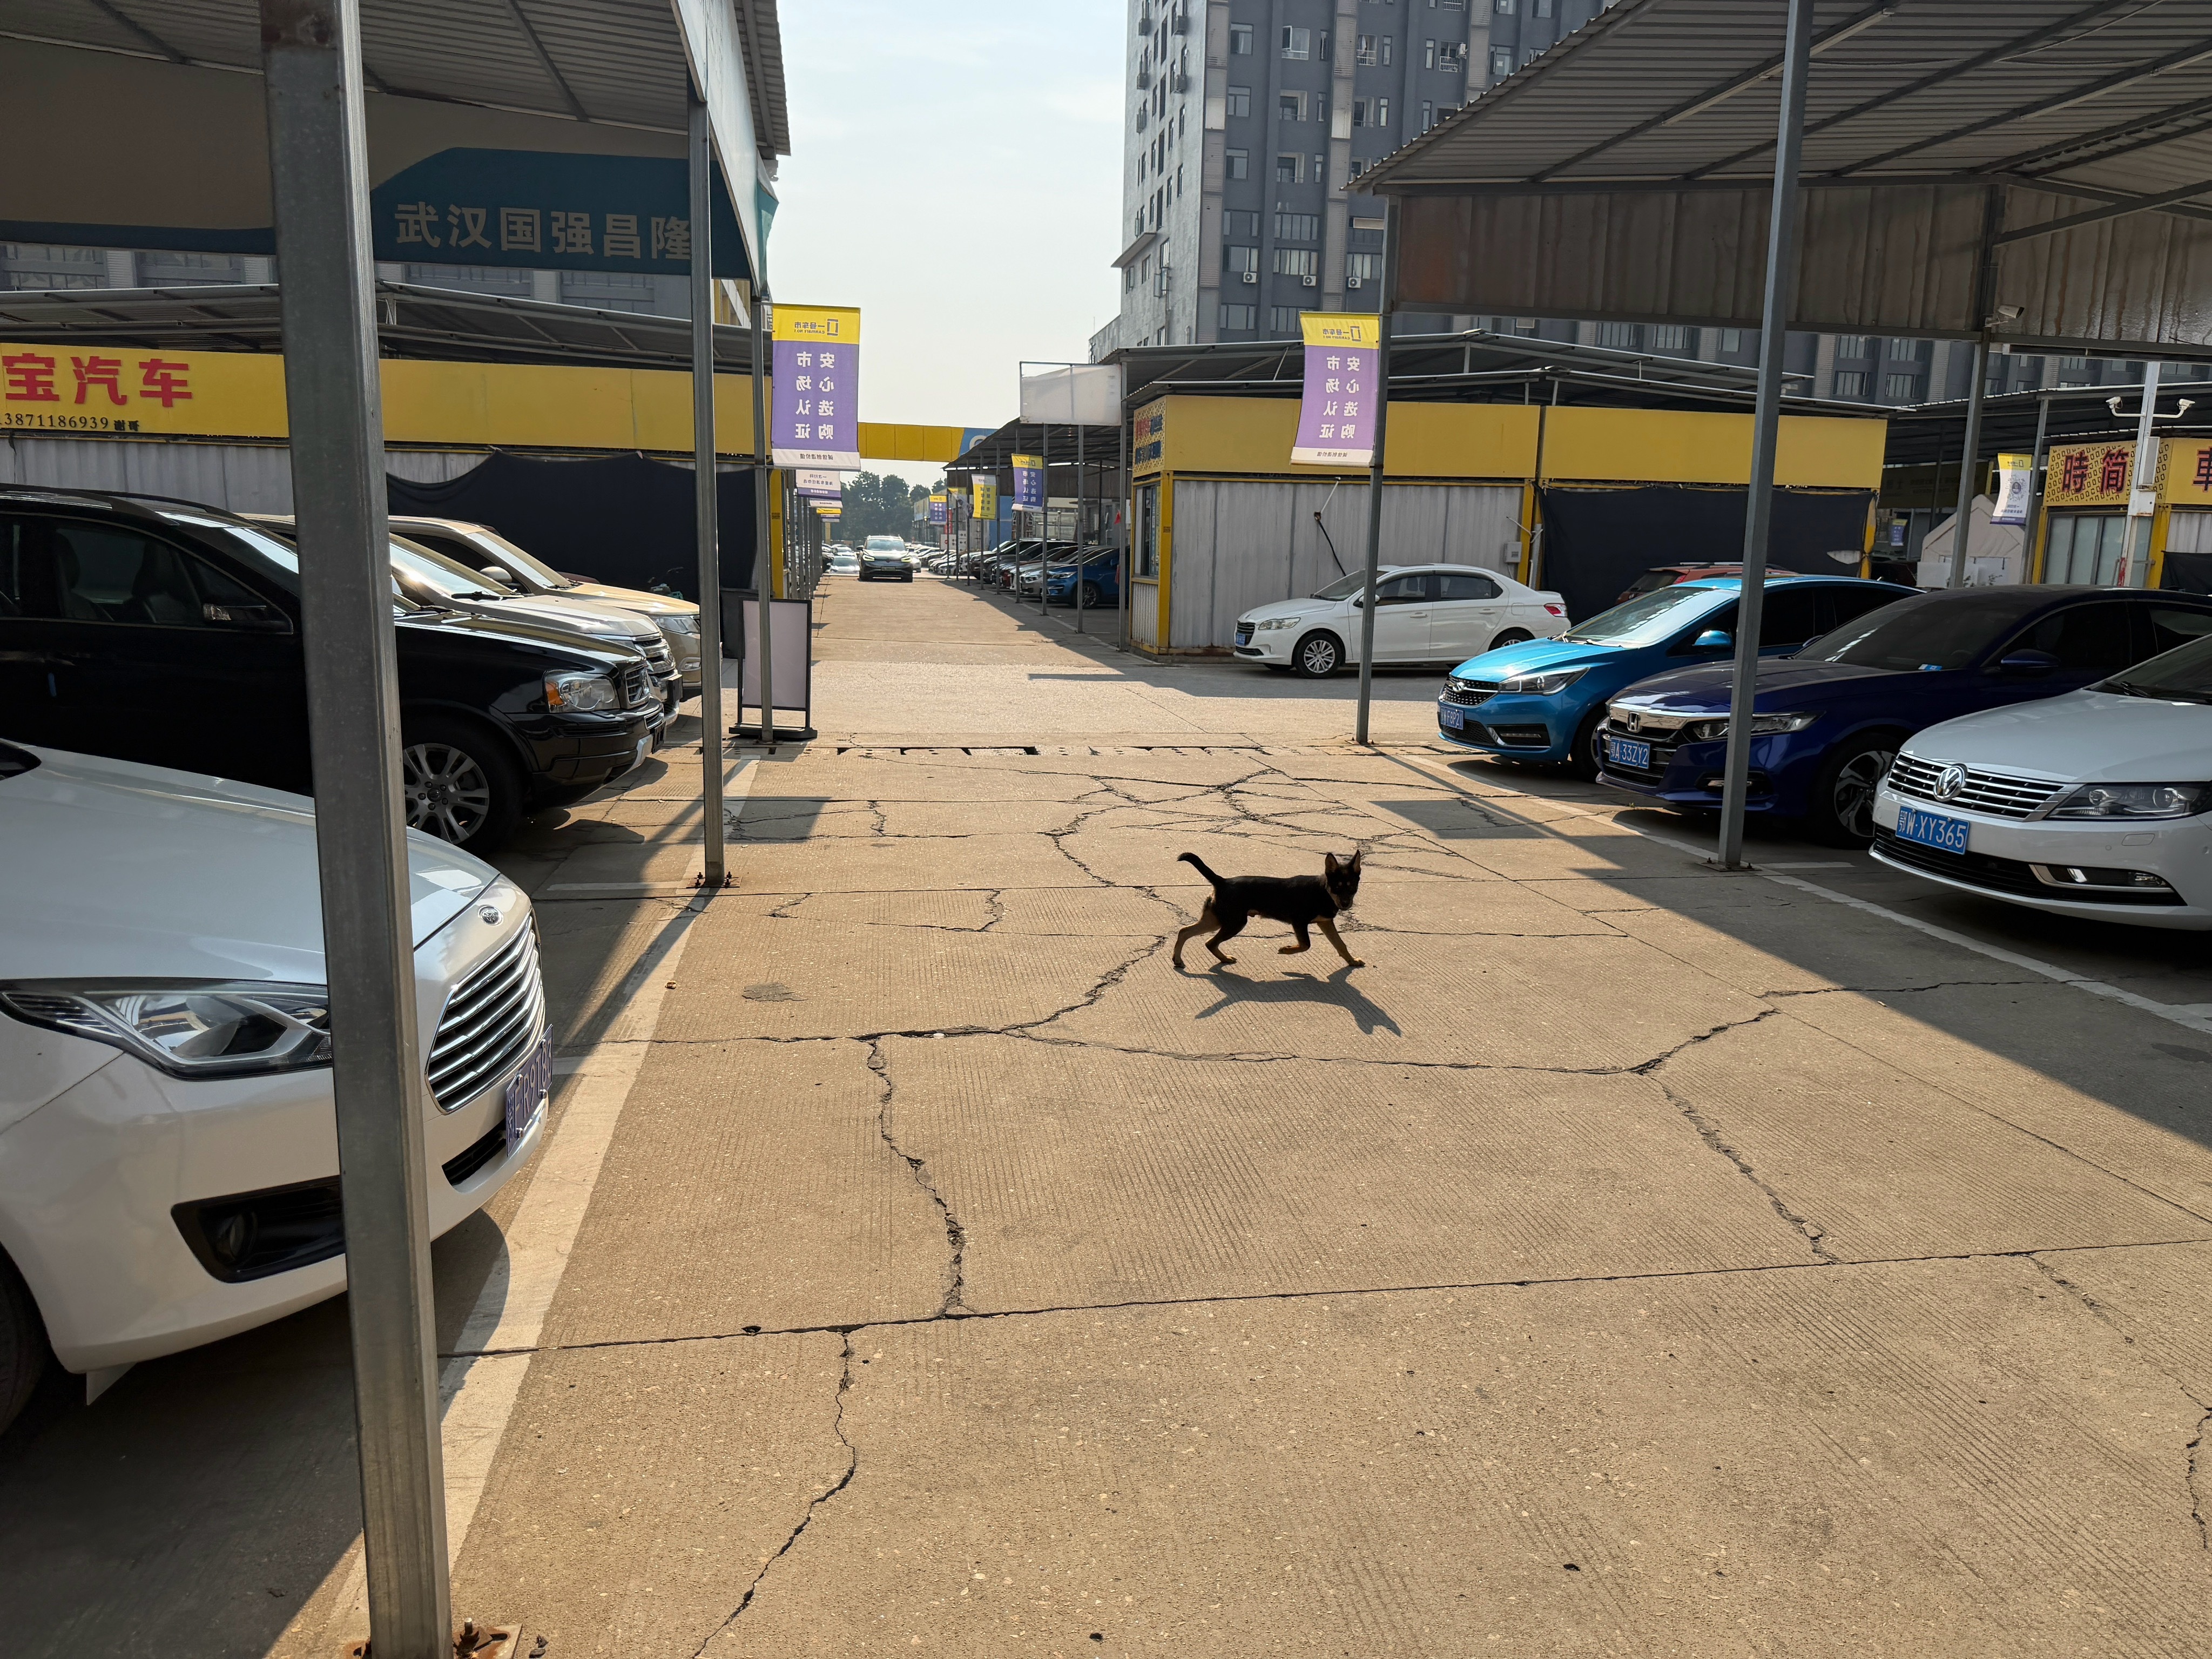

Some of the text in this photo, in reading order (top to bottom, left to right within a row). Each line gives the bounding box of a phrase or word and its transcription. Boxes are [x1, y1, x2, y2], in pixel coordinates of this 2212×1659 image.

[394, 201, 692, 260] 武汉国强昌隆
[2, 353, 193, 407] 宝汽车
[0, 412, 109, 429] 3871186939
